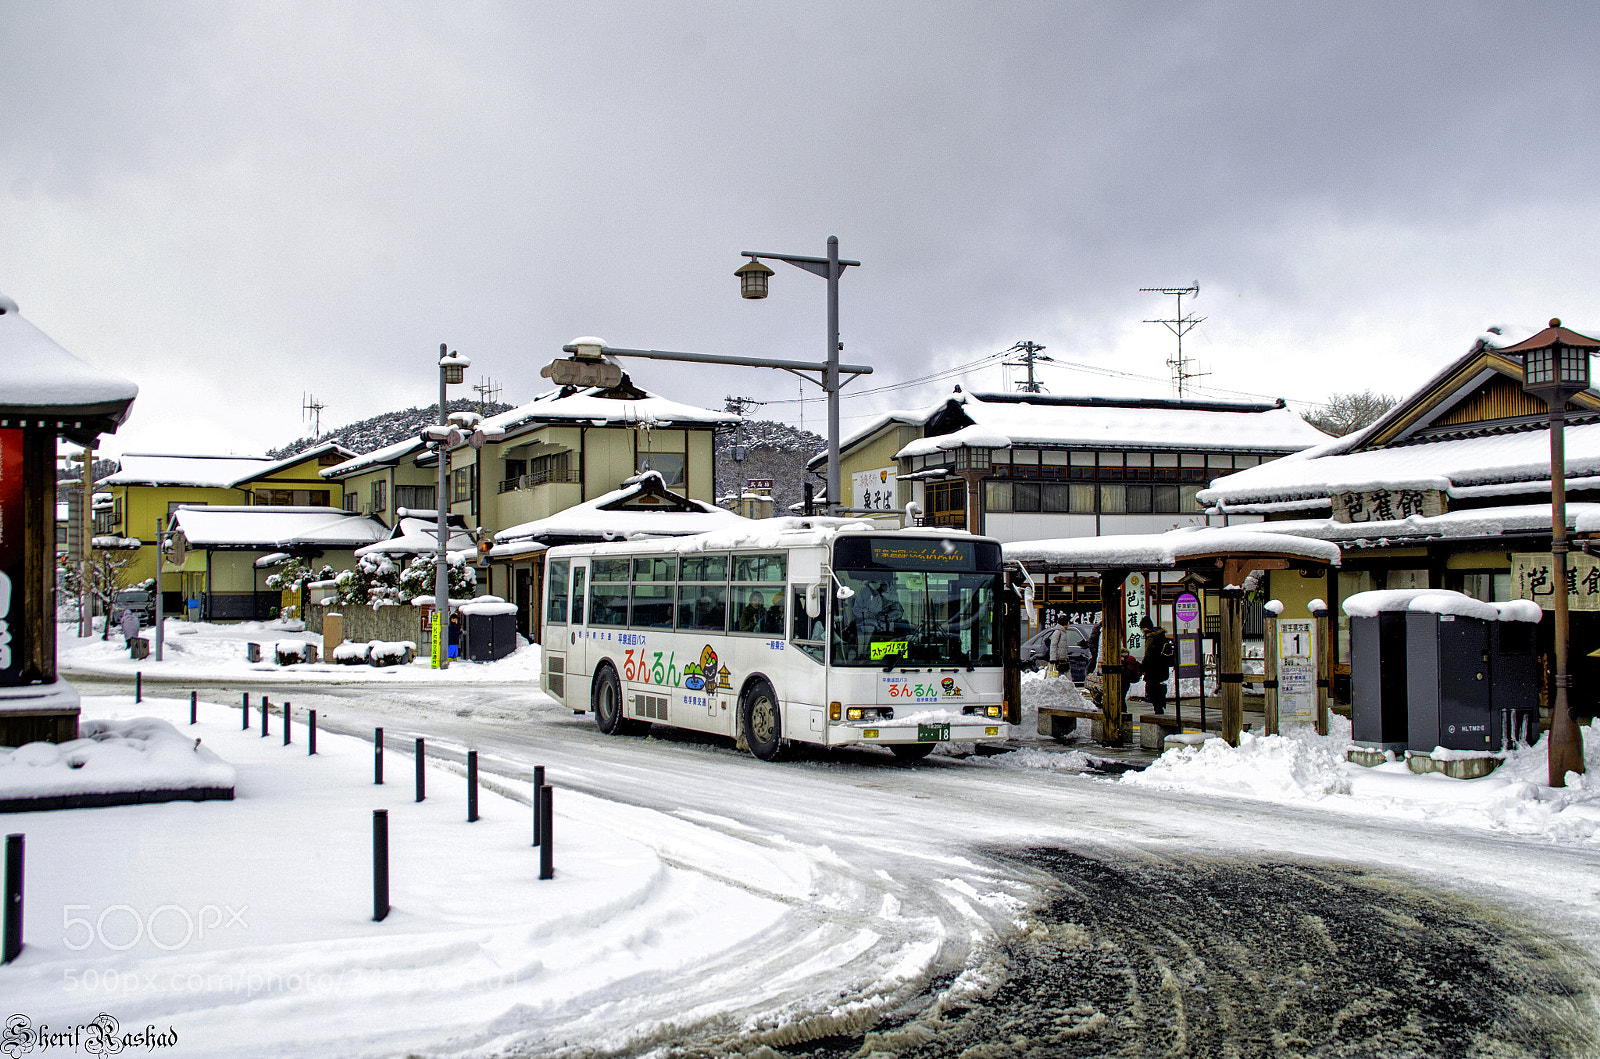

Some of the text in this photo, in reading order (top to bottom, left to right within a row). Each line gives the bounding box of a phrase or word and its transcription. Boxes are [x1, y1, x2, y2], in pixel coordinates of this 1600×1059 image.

[1344, 489, 1424, 523] 芭蕉館
[1126, 590, 1142, 650] 芭蕉館
[1293, 633, 1301, 655] 1
[623, 648, 681, 688] るんるん
[888, 683, 938, 698] るんるん
